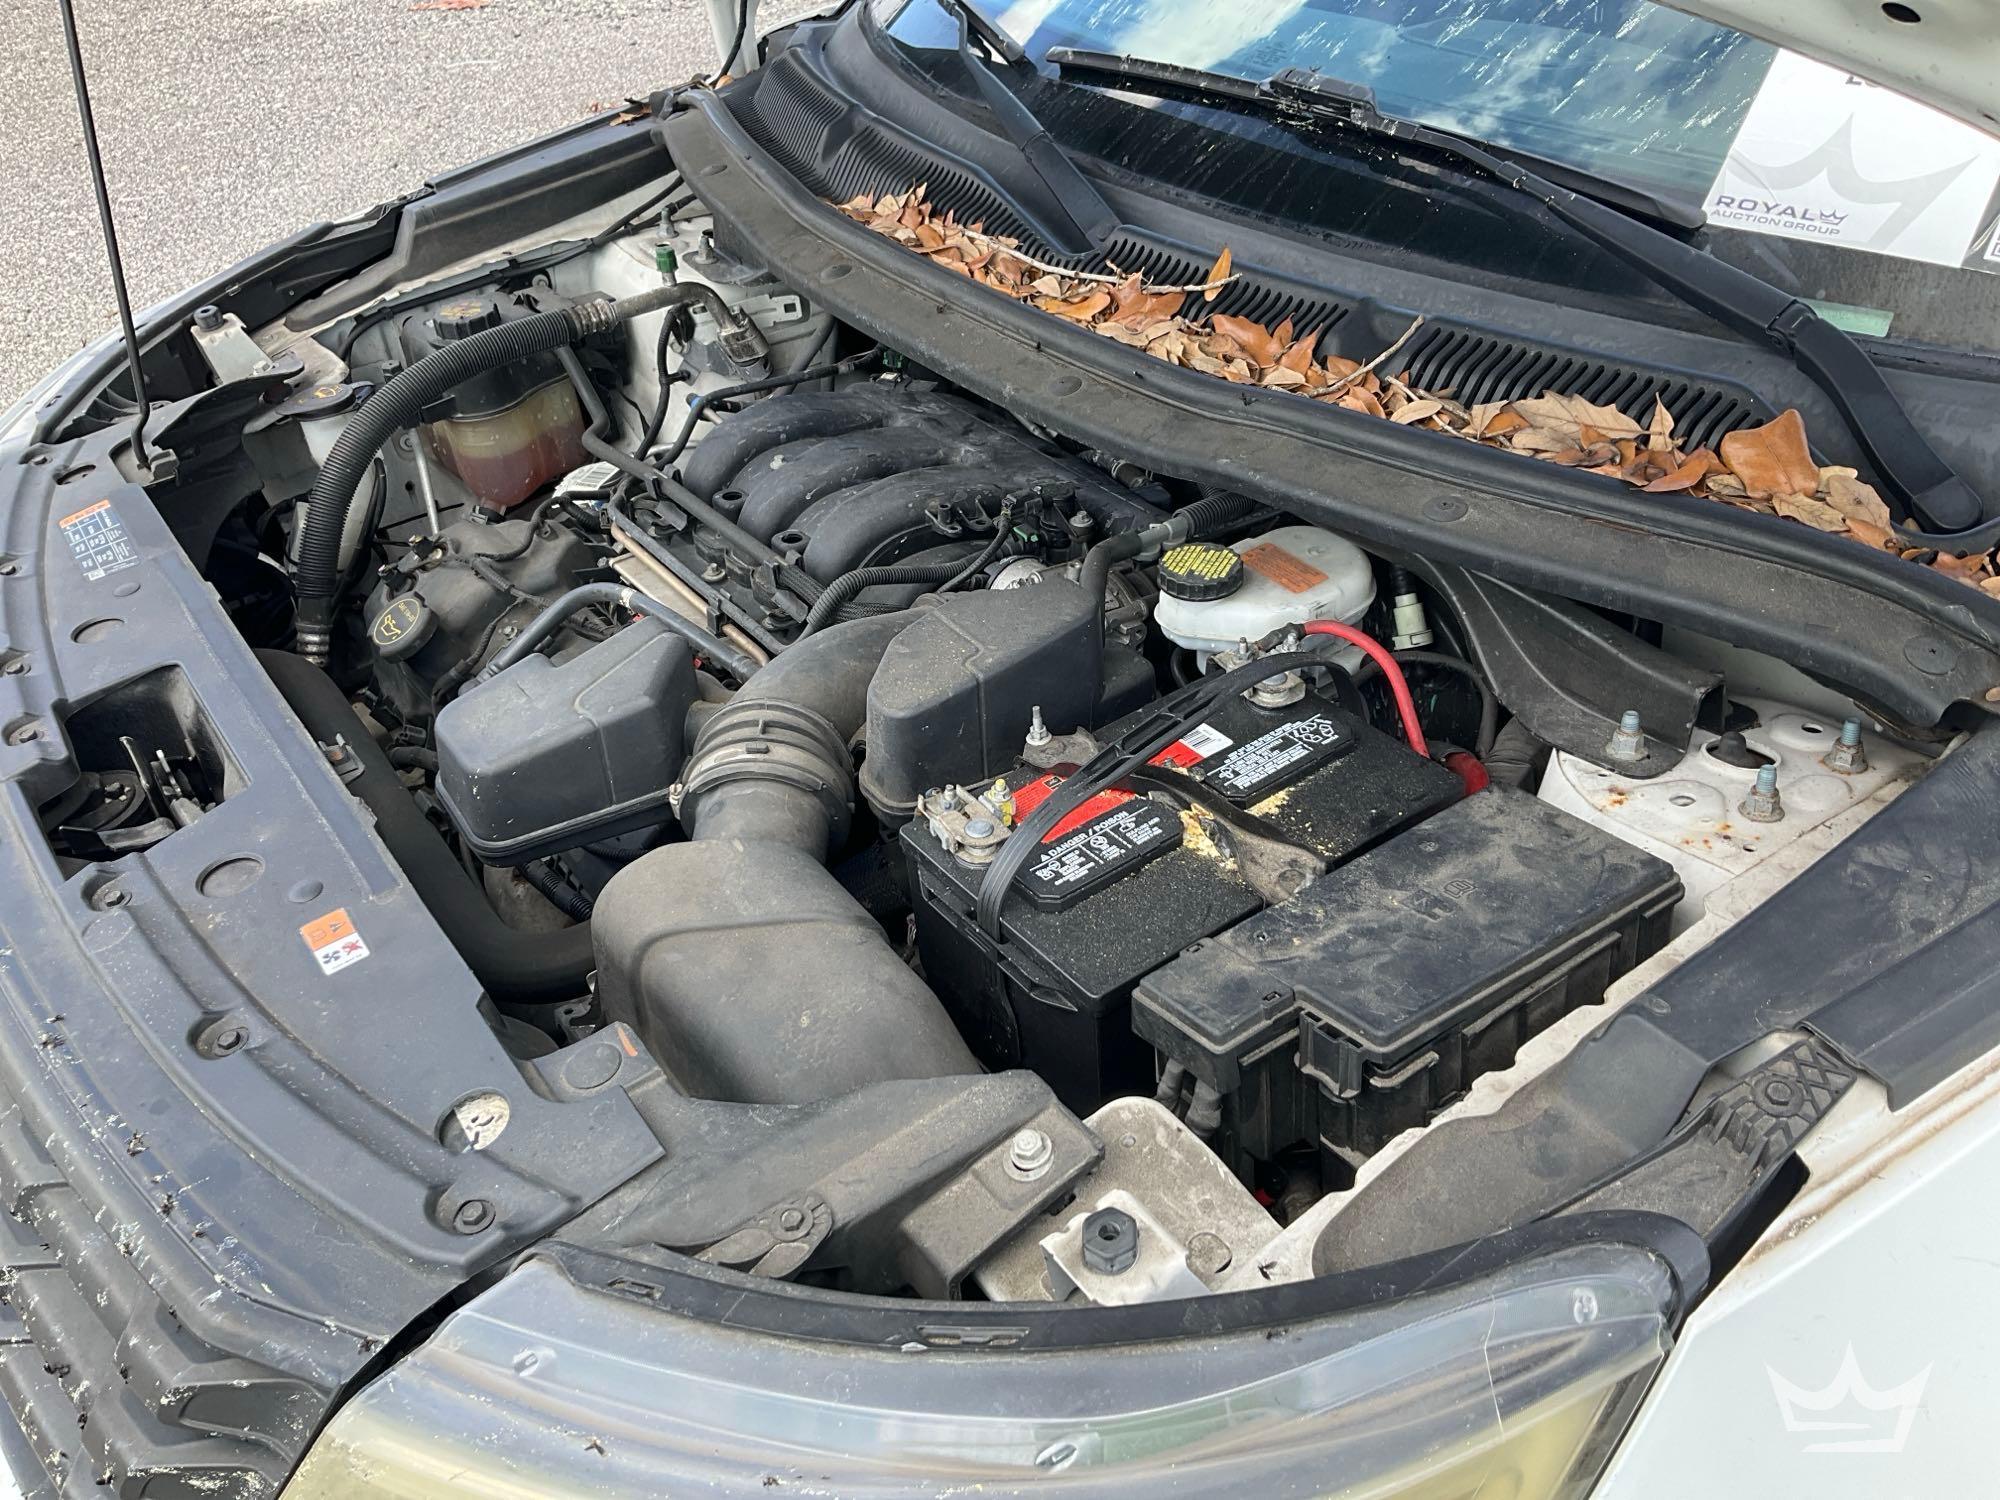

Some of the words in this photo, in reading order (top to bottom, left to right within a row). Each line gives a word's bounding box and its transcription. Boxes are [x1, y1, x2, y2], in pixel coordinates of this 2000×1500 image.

[1711, 208, 1781, 227] AUCTION
[1784, 219, 1840, 236] GROUP
[1716, 195, 1815, 221] ROYAL
[1048, 833, 1088, 857] DANGER
[1093, 811, 1129, 831] POISON
